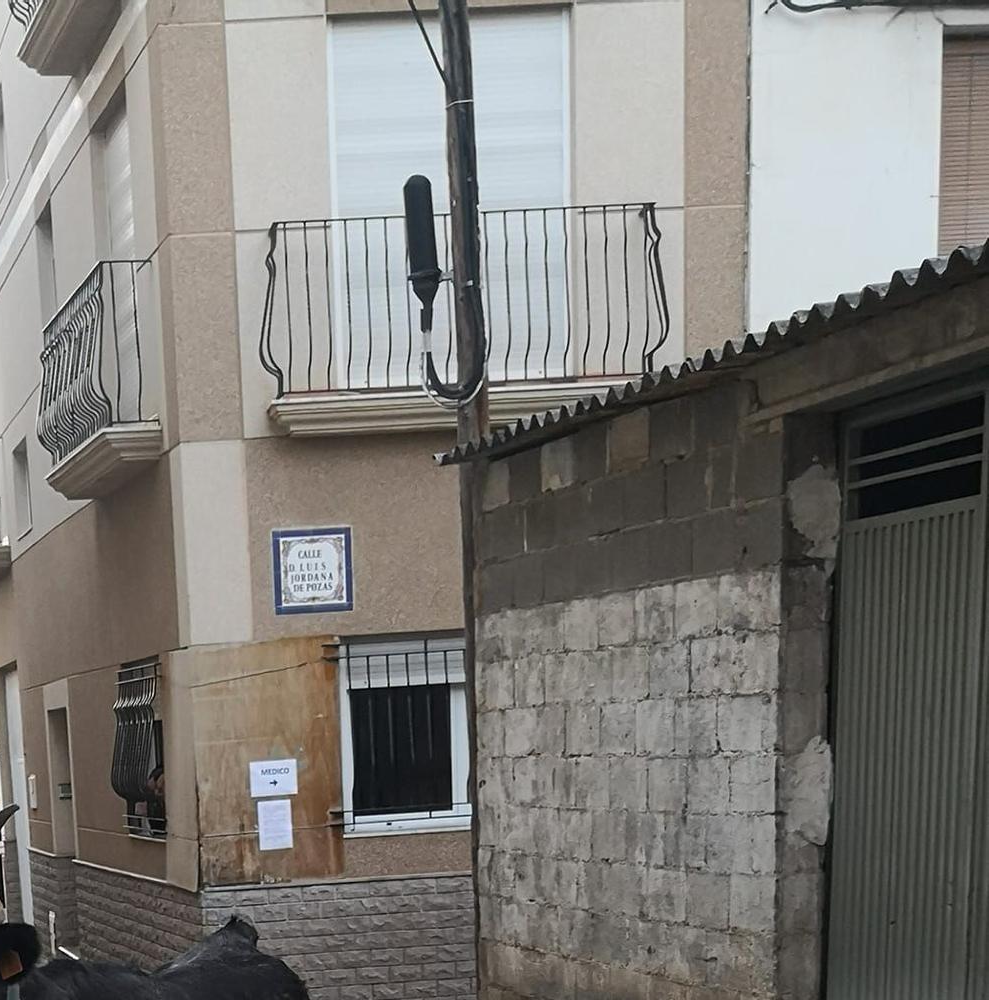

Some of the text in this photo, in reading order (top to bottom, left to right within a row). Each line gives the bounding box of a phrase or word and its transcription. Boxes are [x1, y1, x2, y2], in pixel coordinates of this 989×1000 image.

[297, 549, 322, 559] CALLE
[299, 562, 326, 572] LUIS
[291, 572, 333, 584] JORDANA
[293, 582, 333, 592] DE POZAS
[260, 767, 290, 775] MEDICO
